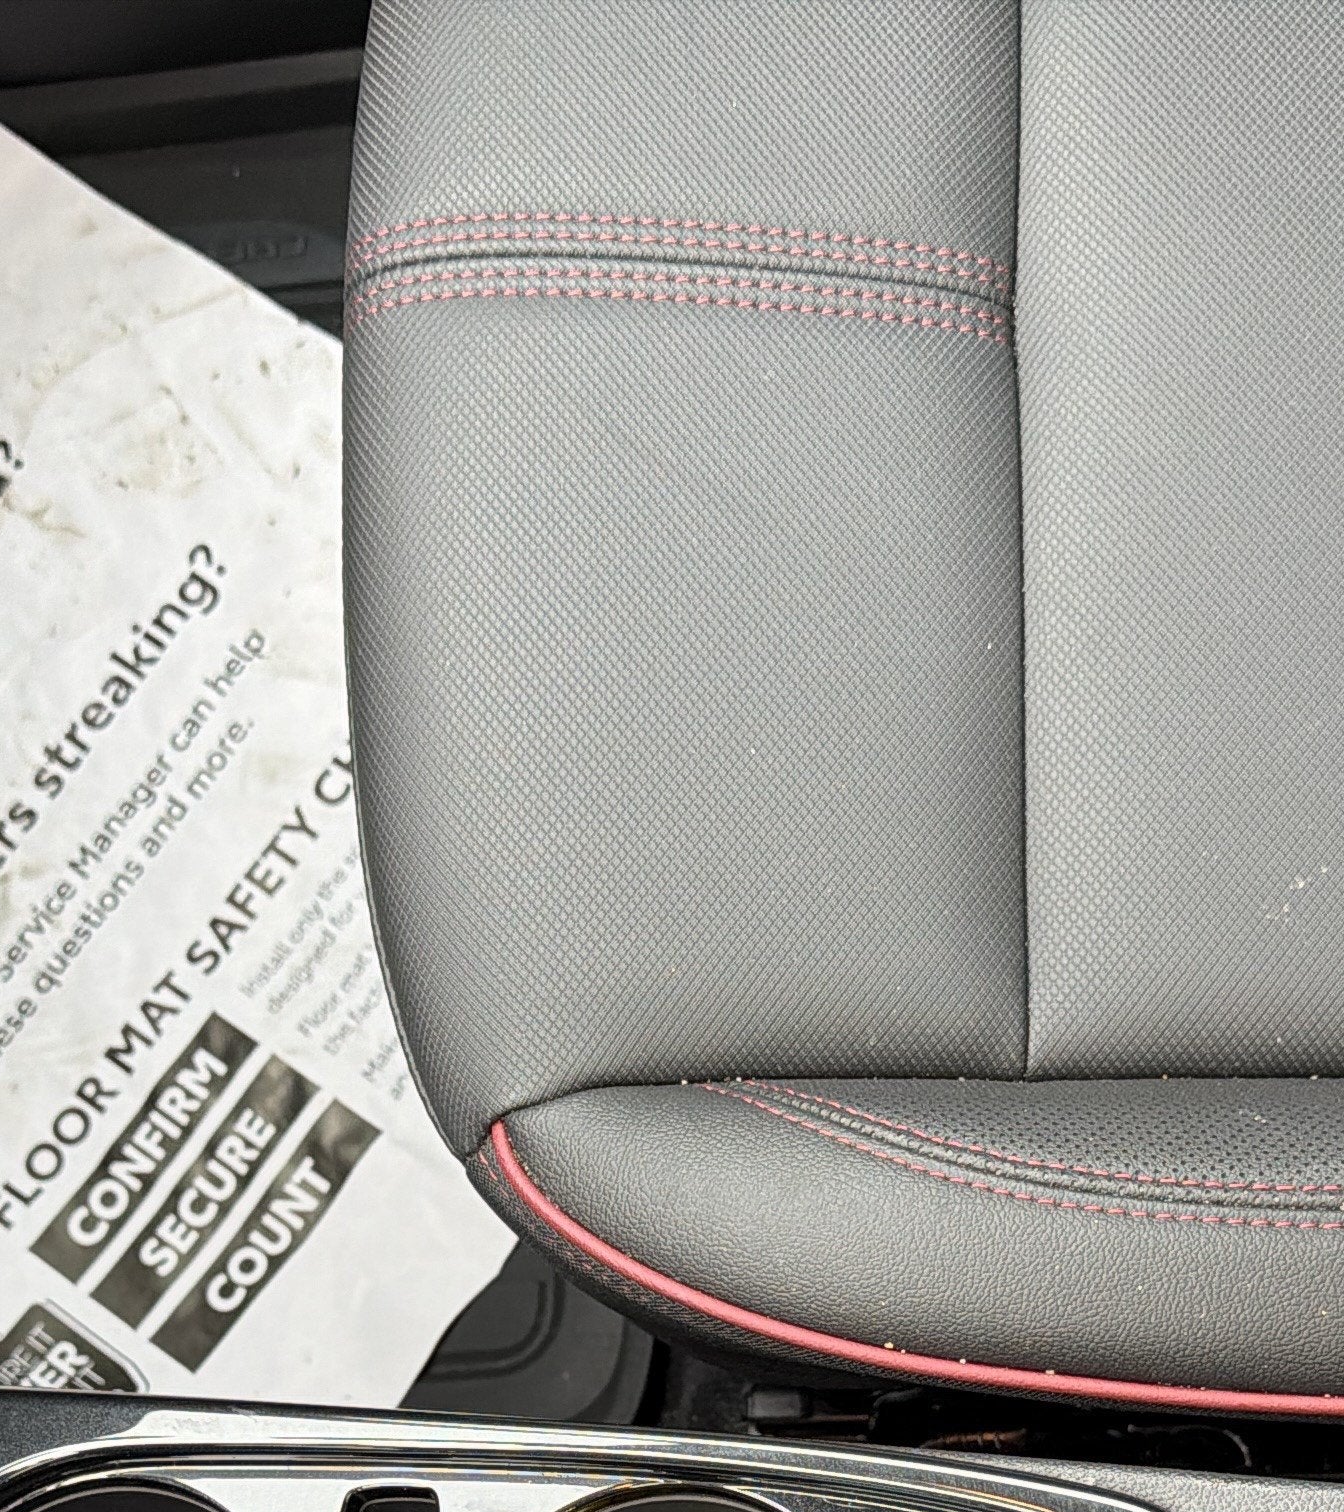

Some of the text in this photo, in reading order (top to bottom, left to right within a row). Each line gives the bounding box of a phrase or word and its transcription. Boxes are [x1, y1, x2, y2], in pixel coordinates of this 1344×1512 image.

[34, 544, 228, 799] streaking?
[69, 755, 172, 879] Manager
[170, 699, 216, 752] can
[204, 629, 268, 696] help
[35, 868, 145, 994] questions
[142, 795, 187, 857] and
[188, 718, 255, 801] more.
[105, 971, 193, 1073] MAT
[185, 806, 319, 976] SAFETY
[67, 1046, 229, 1248] CONFIRM
[138, 1108, 276, 1277] SECURE
[205, 1157, 333, 1313] COUNT
